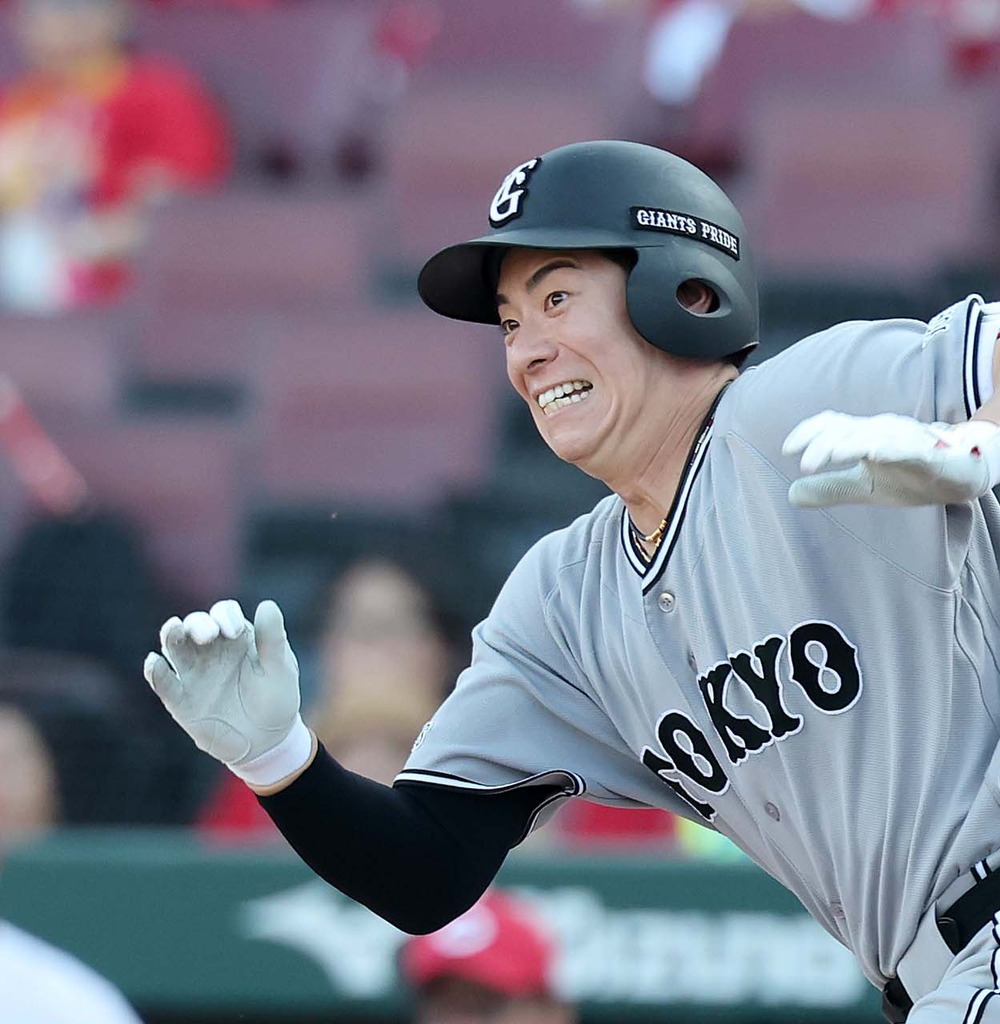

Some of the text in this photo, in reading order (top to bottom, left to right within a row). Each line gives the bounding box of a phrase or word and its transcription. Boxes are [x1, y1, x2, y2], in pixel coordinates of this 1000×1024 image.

[636, 209, 738, 254] GIANTS PRIDE
[640, 619, 863, 822] TOKYO
